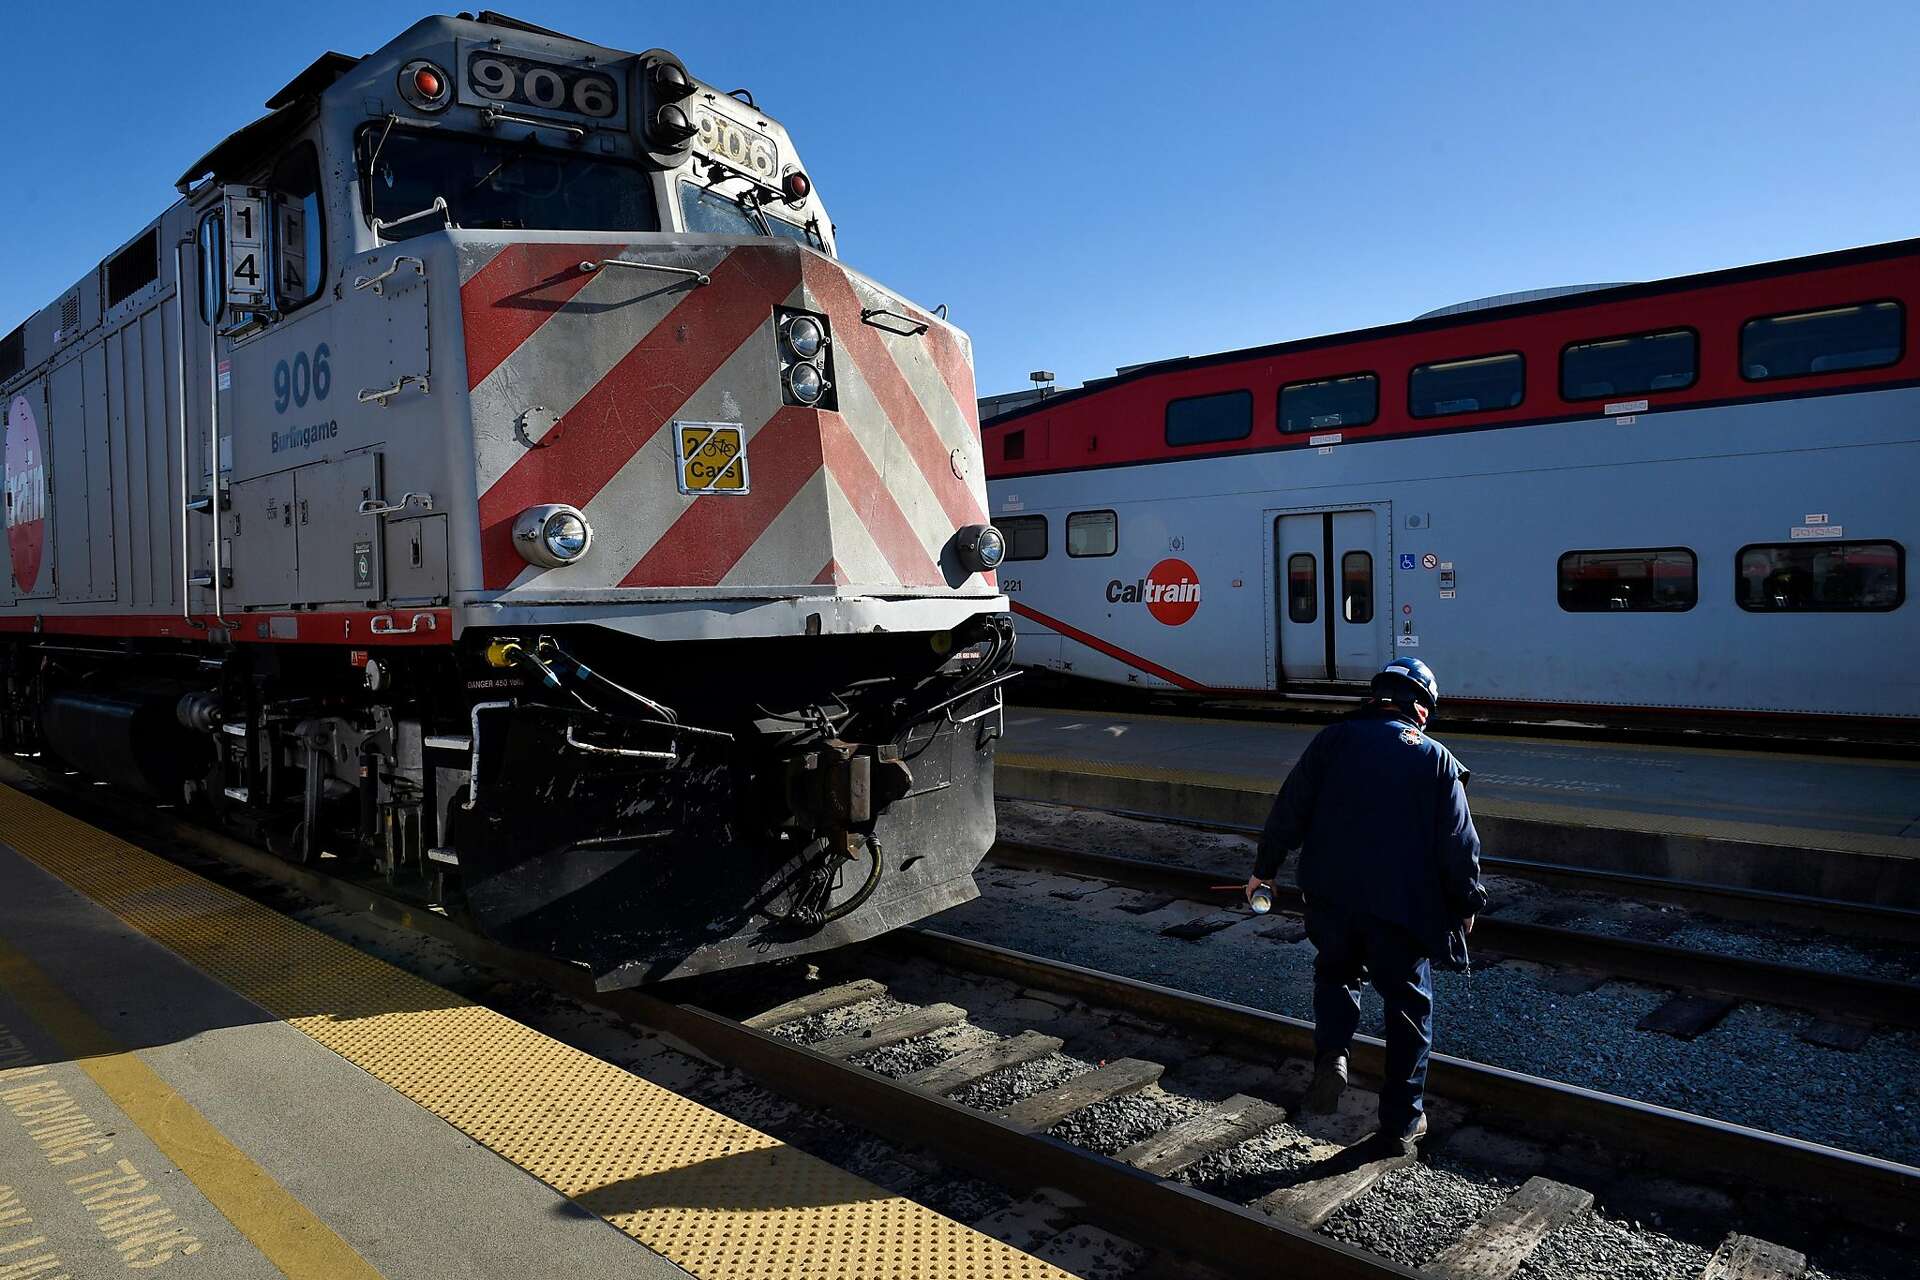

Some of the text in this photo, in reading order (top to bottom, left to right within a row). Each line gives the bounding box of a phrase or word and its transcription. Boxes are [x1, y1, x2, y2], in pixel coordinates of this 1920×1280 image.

[472, 58, 616, 118] 906
[699, 113, 773, 177] 906
[236, 207, 252, 238] 1
[233, 254, 260, 286] 4
[273, 342, 331, 414] 906
[272, 419, 338, 453] Burlingame
[687, 438, 701, 457] 2
[691, 461, 735, 478] Cars
[1003, 580, 1023, 592] 221
[1105, 577, 1201, 604] Caltrain
[467, 680, 493, 689] DANGER
[66, 1158, 204, 1269] TRAINS
